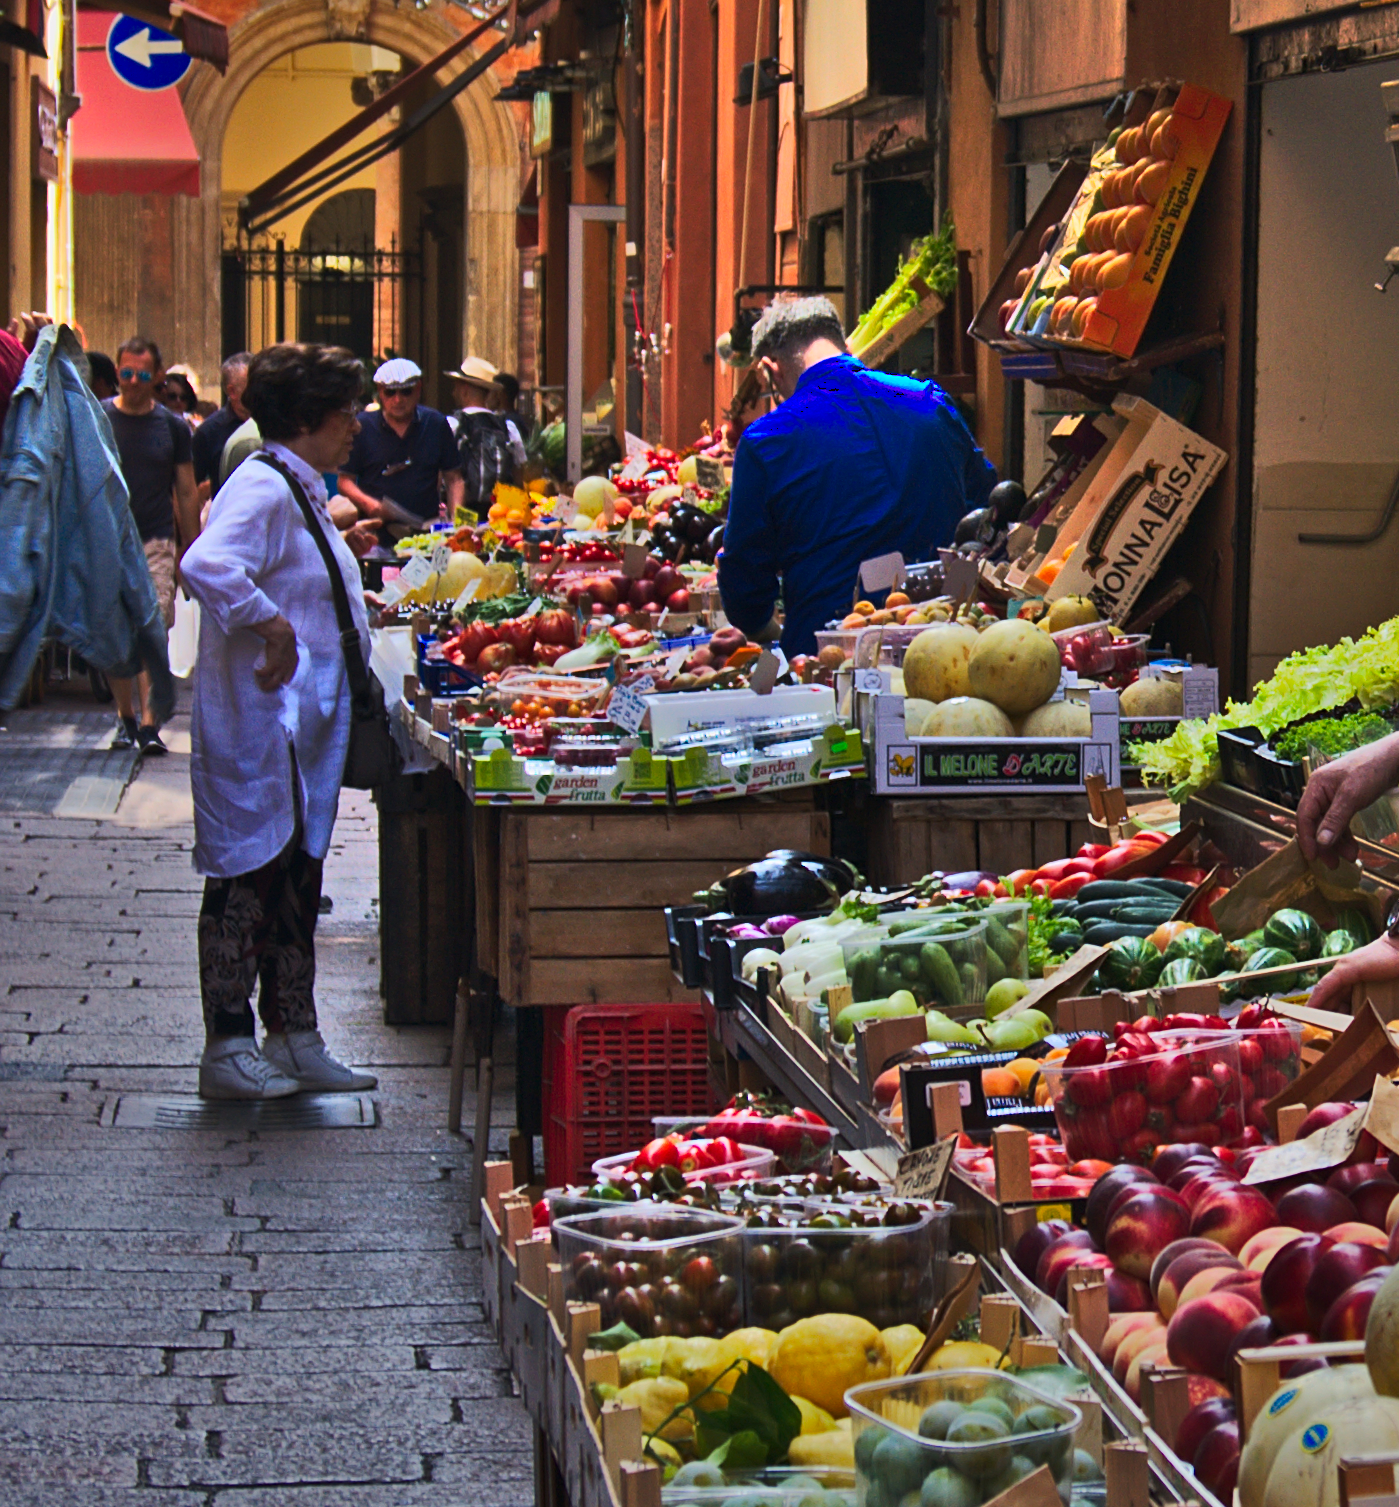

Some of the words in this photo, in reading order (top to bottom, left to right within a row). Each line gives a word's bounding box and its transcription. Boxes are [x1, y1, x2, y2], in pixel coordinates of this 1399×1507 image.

[1143, 222, 1176, 284] Famiglia
[1169, 166, 1198, 221] Bighini
[1090, 519, 1111, 553] Special
[1107, 477, 1142, 520] Selection
[752, 760, 796, 779] garden
[924, 755, 938, 777] IL
[940, 753, 998, 777] MELONE
[1002, 753, 1077, 777] D'ARTE
[554, 776, 598, 791] garden
[769, 771, 806, 787] frutta
[569, 788, 606, 802] frutta
